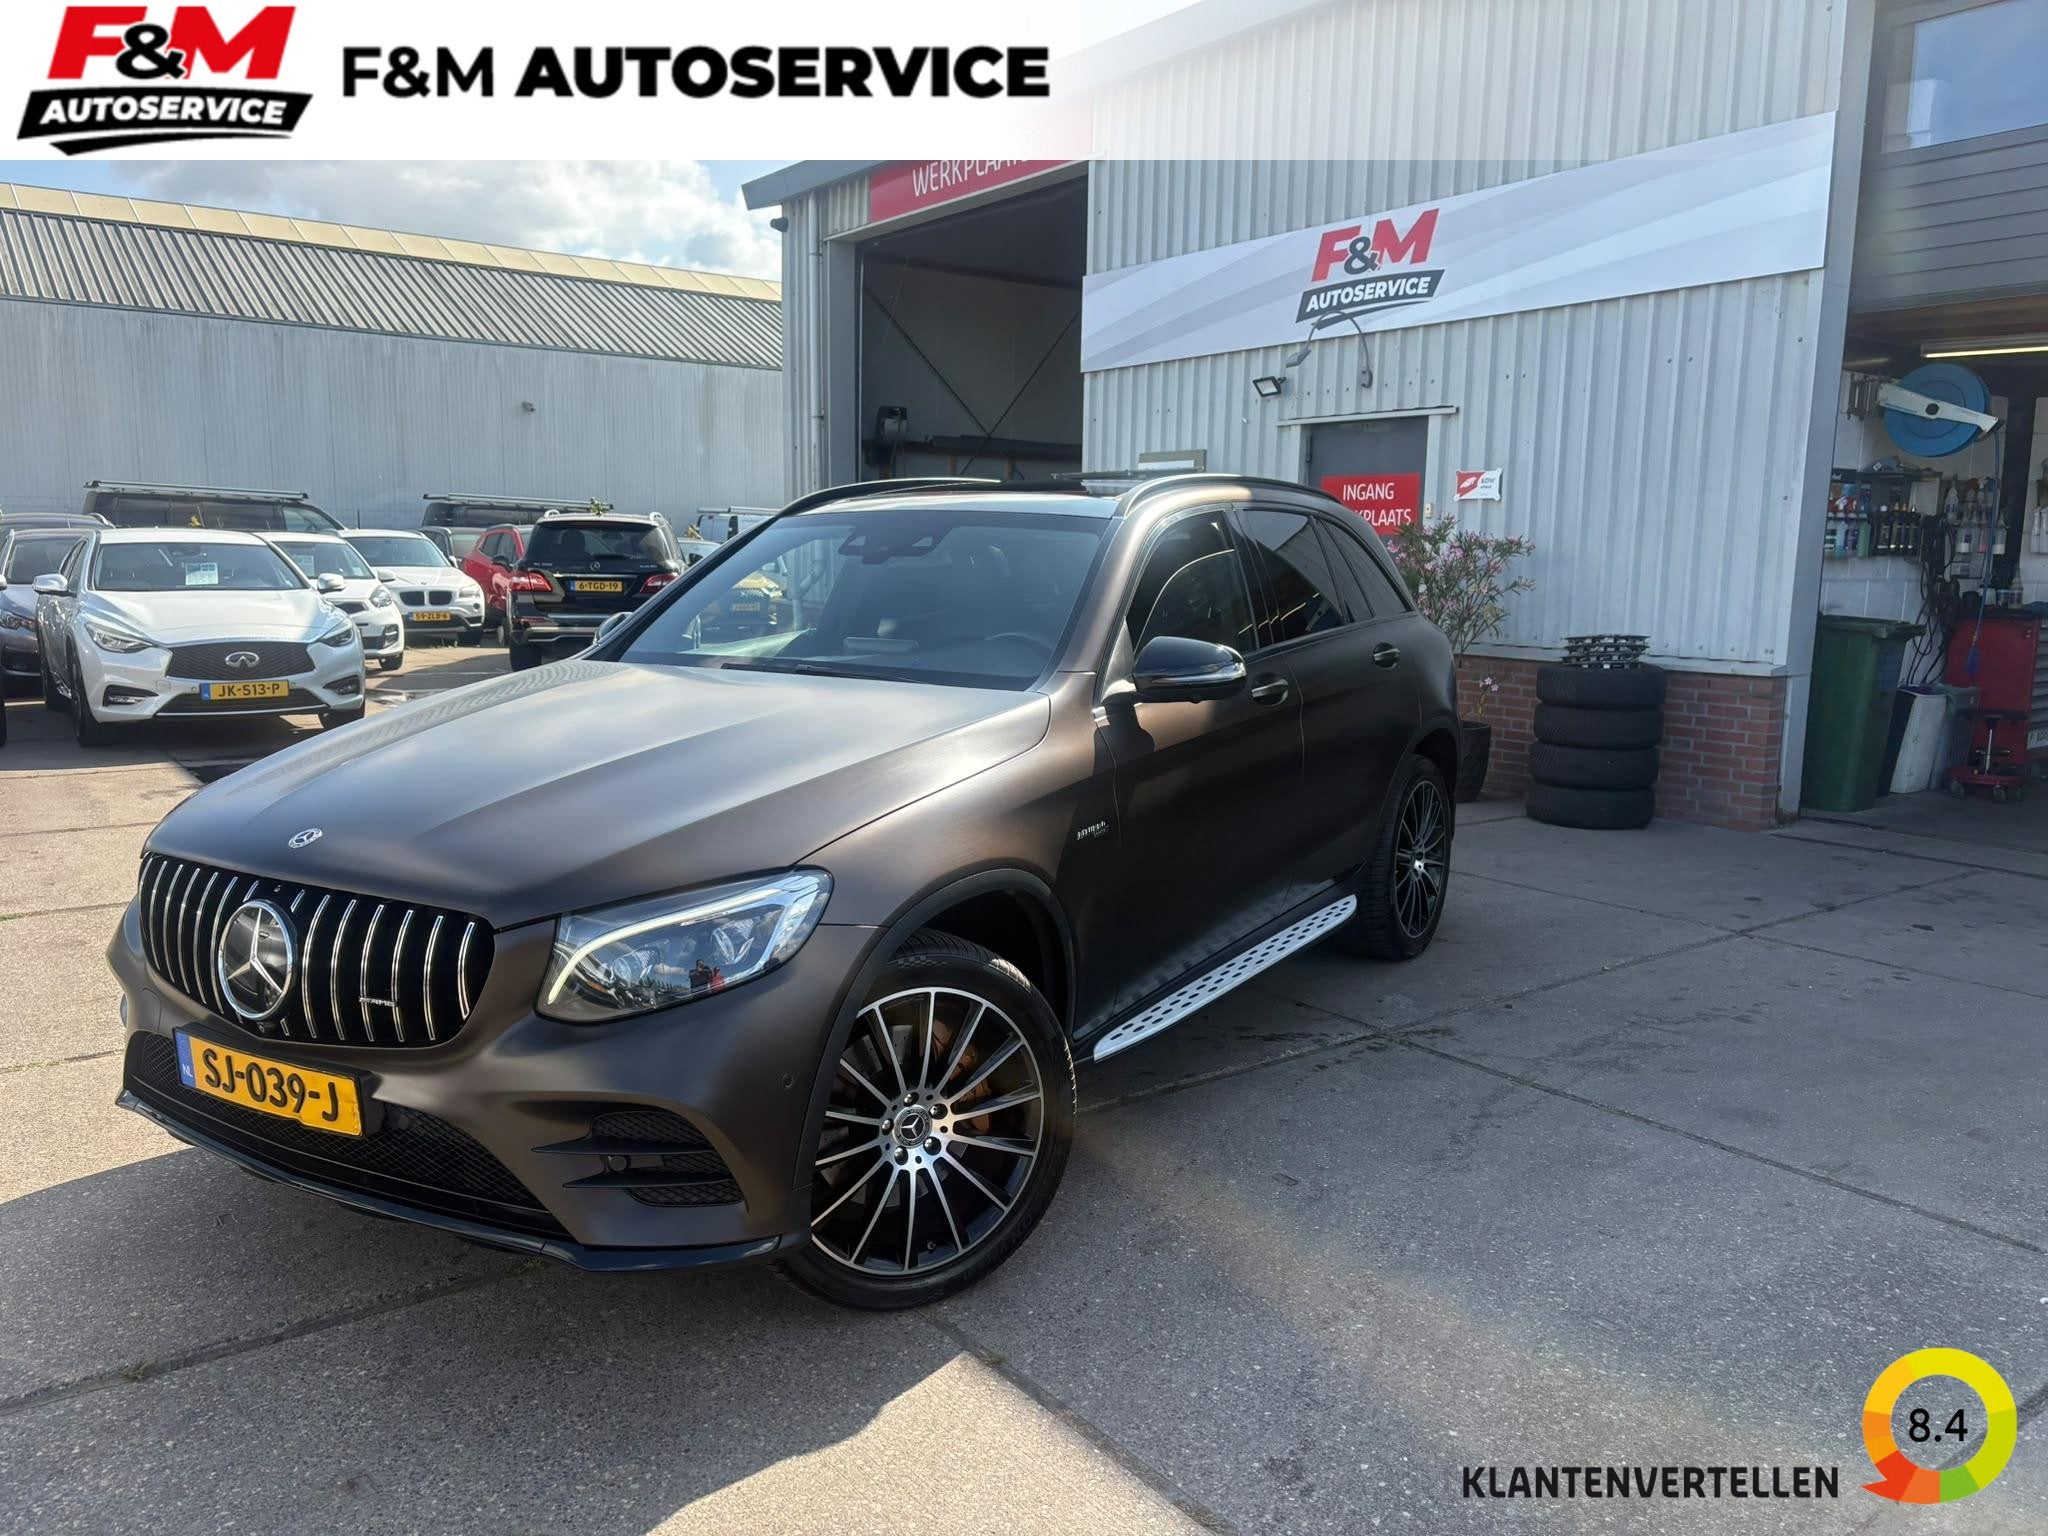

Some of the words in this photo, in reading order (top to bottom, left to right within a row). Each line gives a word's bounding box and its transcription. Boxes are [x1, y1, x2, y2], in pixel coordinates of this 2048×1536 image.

[1311, 208, 1440, 282] F&M
[1306, 277, 1431, 313] AUTOSERVICE
[1343, 483, 1394, 501] INGANG
[1354, 508, 1412, 527] PLAATS
[579, 582, 619, 591] 6-TGD-19
[218, 683, 280, 697] JK-513-P
[202, 1048, 339, 1122] SJ-039-J
